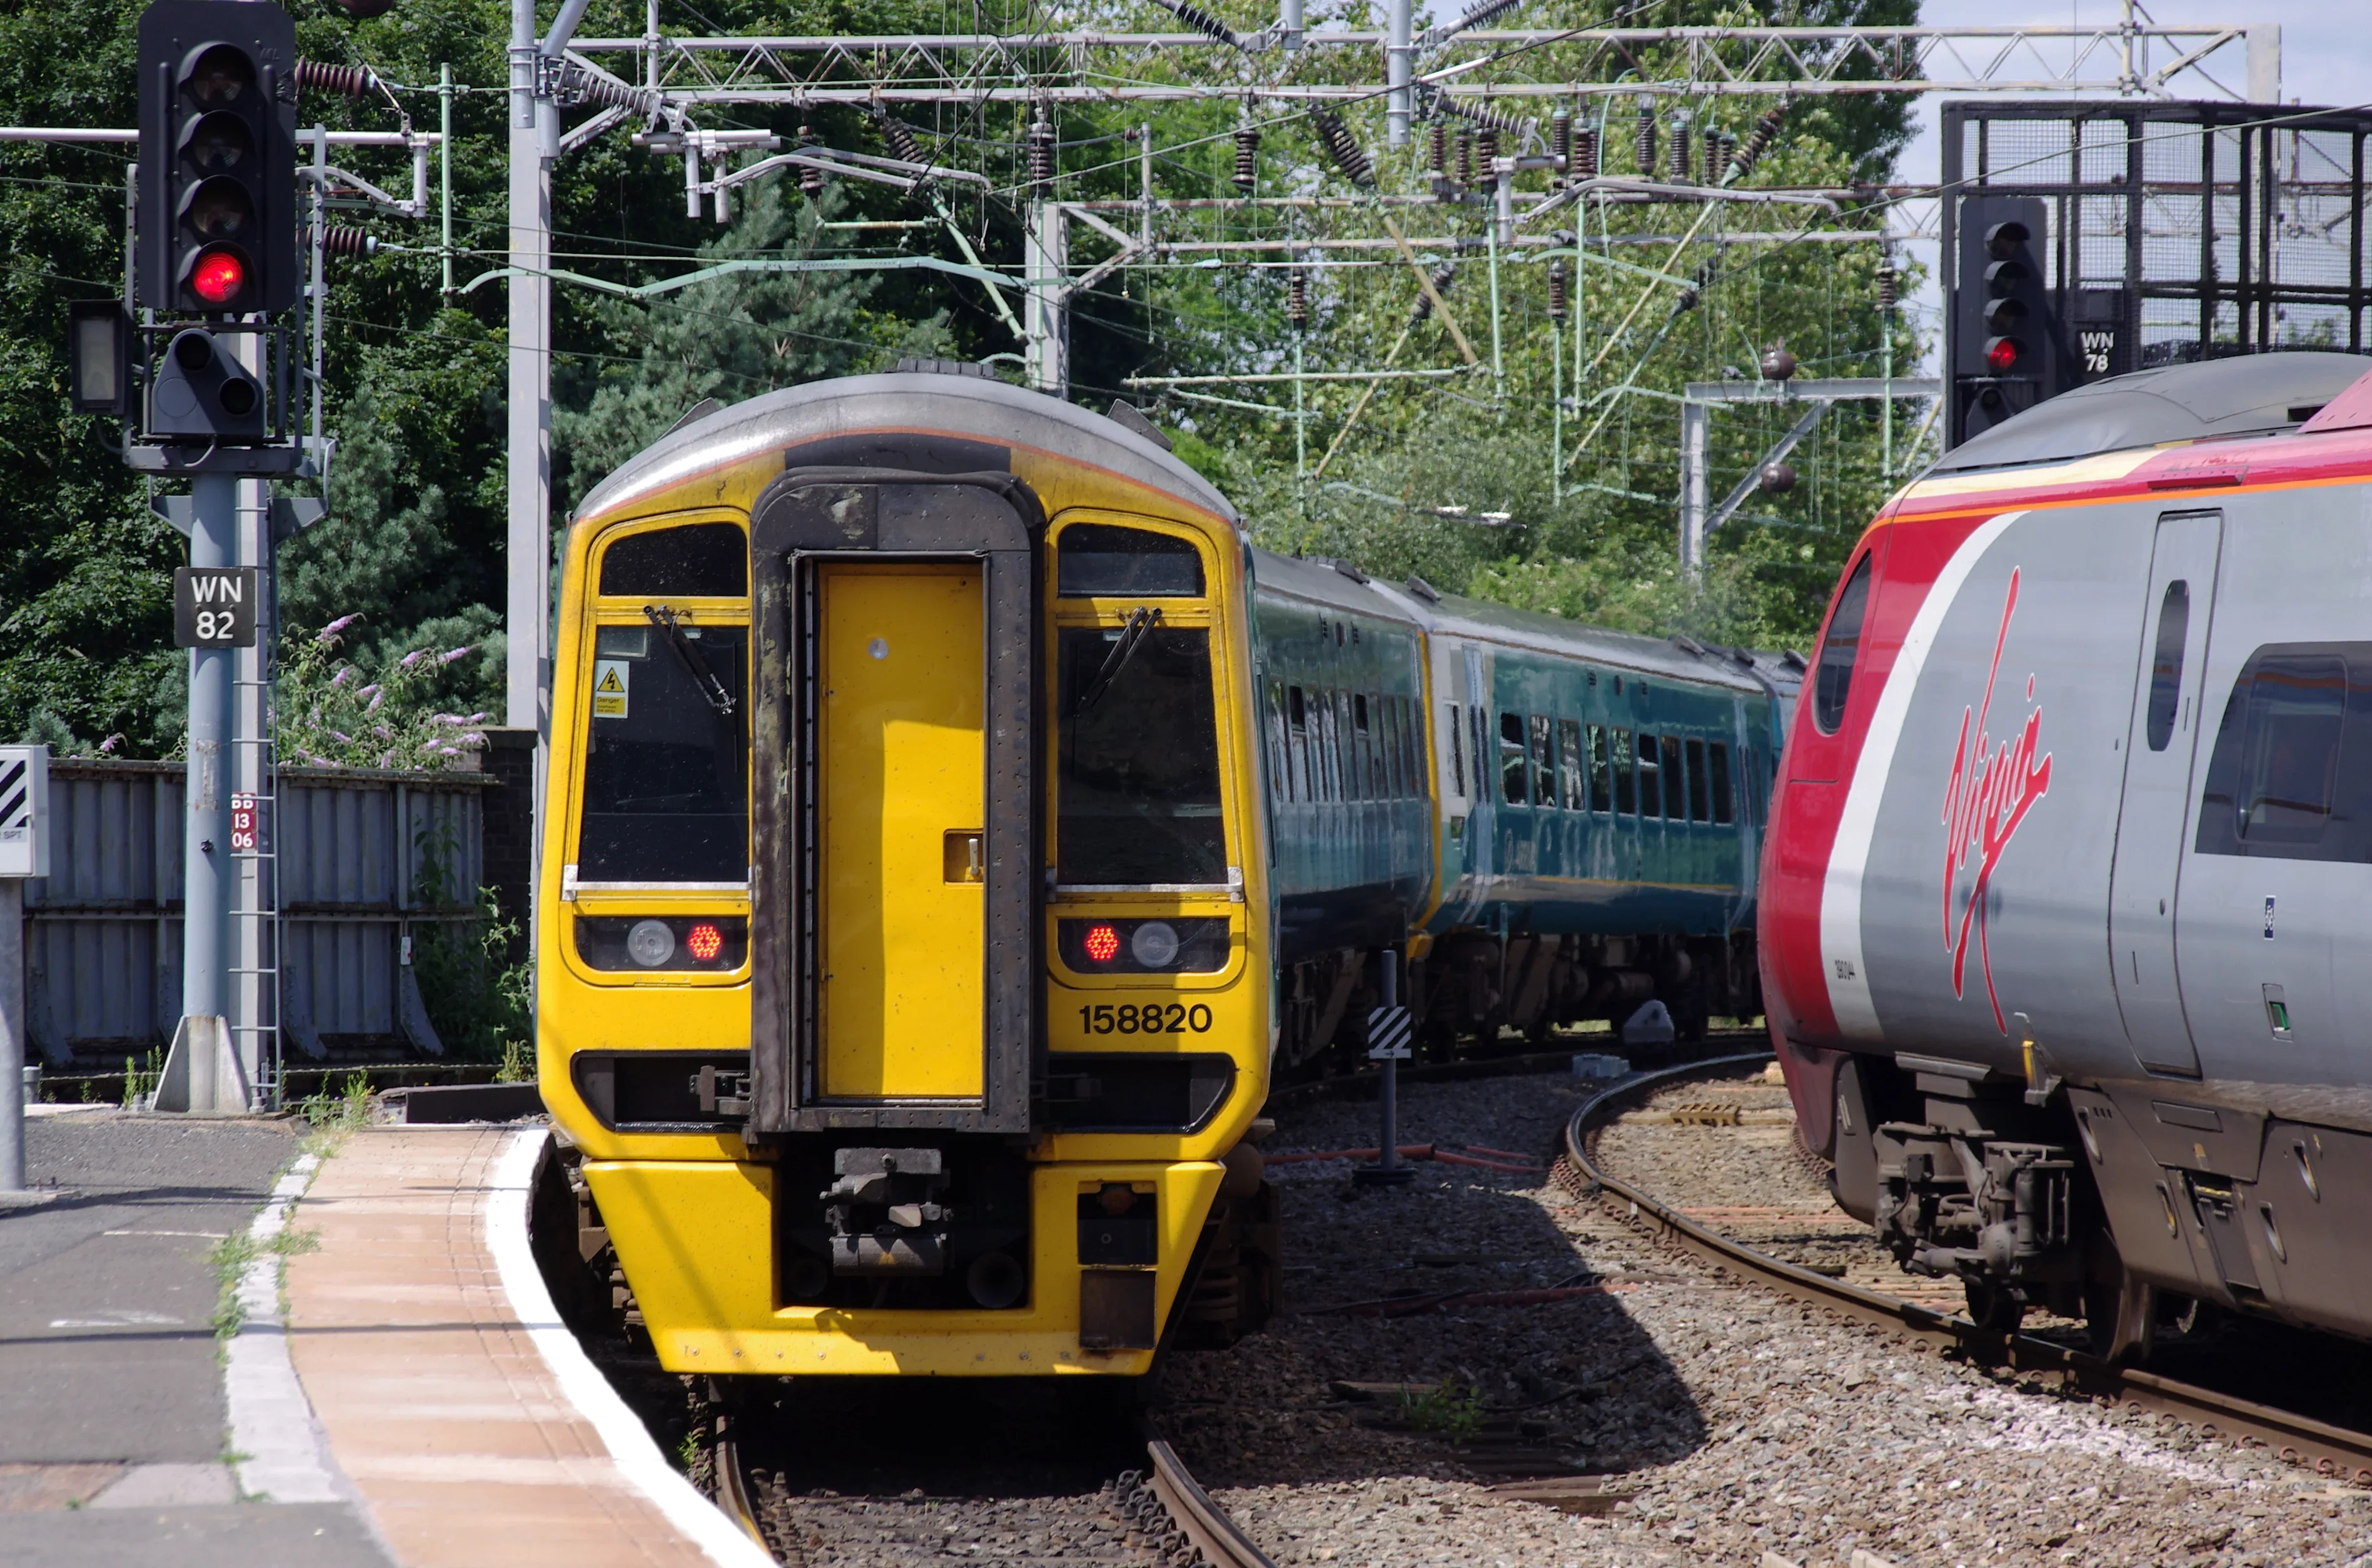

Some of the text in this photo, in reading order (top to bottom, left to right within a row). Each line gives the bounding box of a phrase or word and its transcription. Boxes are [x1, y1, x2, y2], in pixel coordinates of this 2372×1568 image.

[2081, 331, 2114, 349] WN
[2084, 353, 2109, 373] 78
[190, 576, 242, 603] WN
[196, 611, 235, 639] 82
[231, 793, 253, 810] BB
[1942, 565, 2052, 1037] Virgin
[235, 813, 250, 829] 13
[231, 832, 253, 848] 06
[1079, 1003, 1213, 1034] 158820
